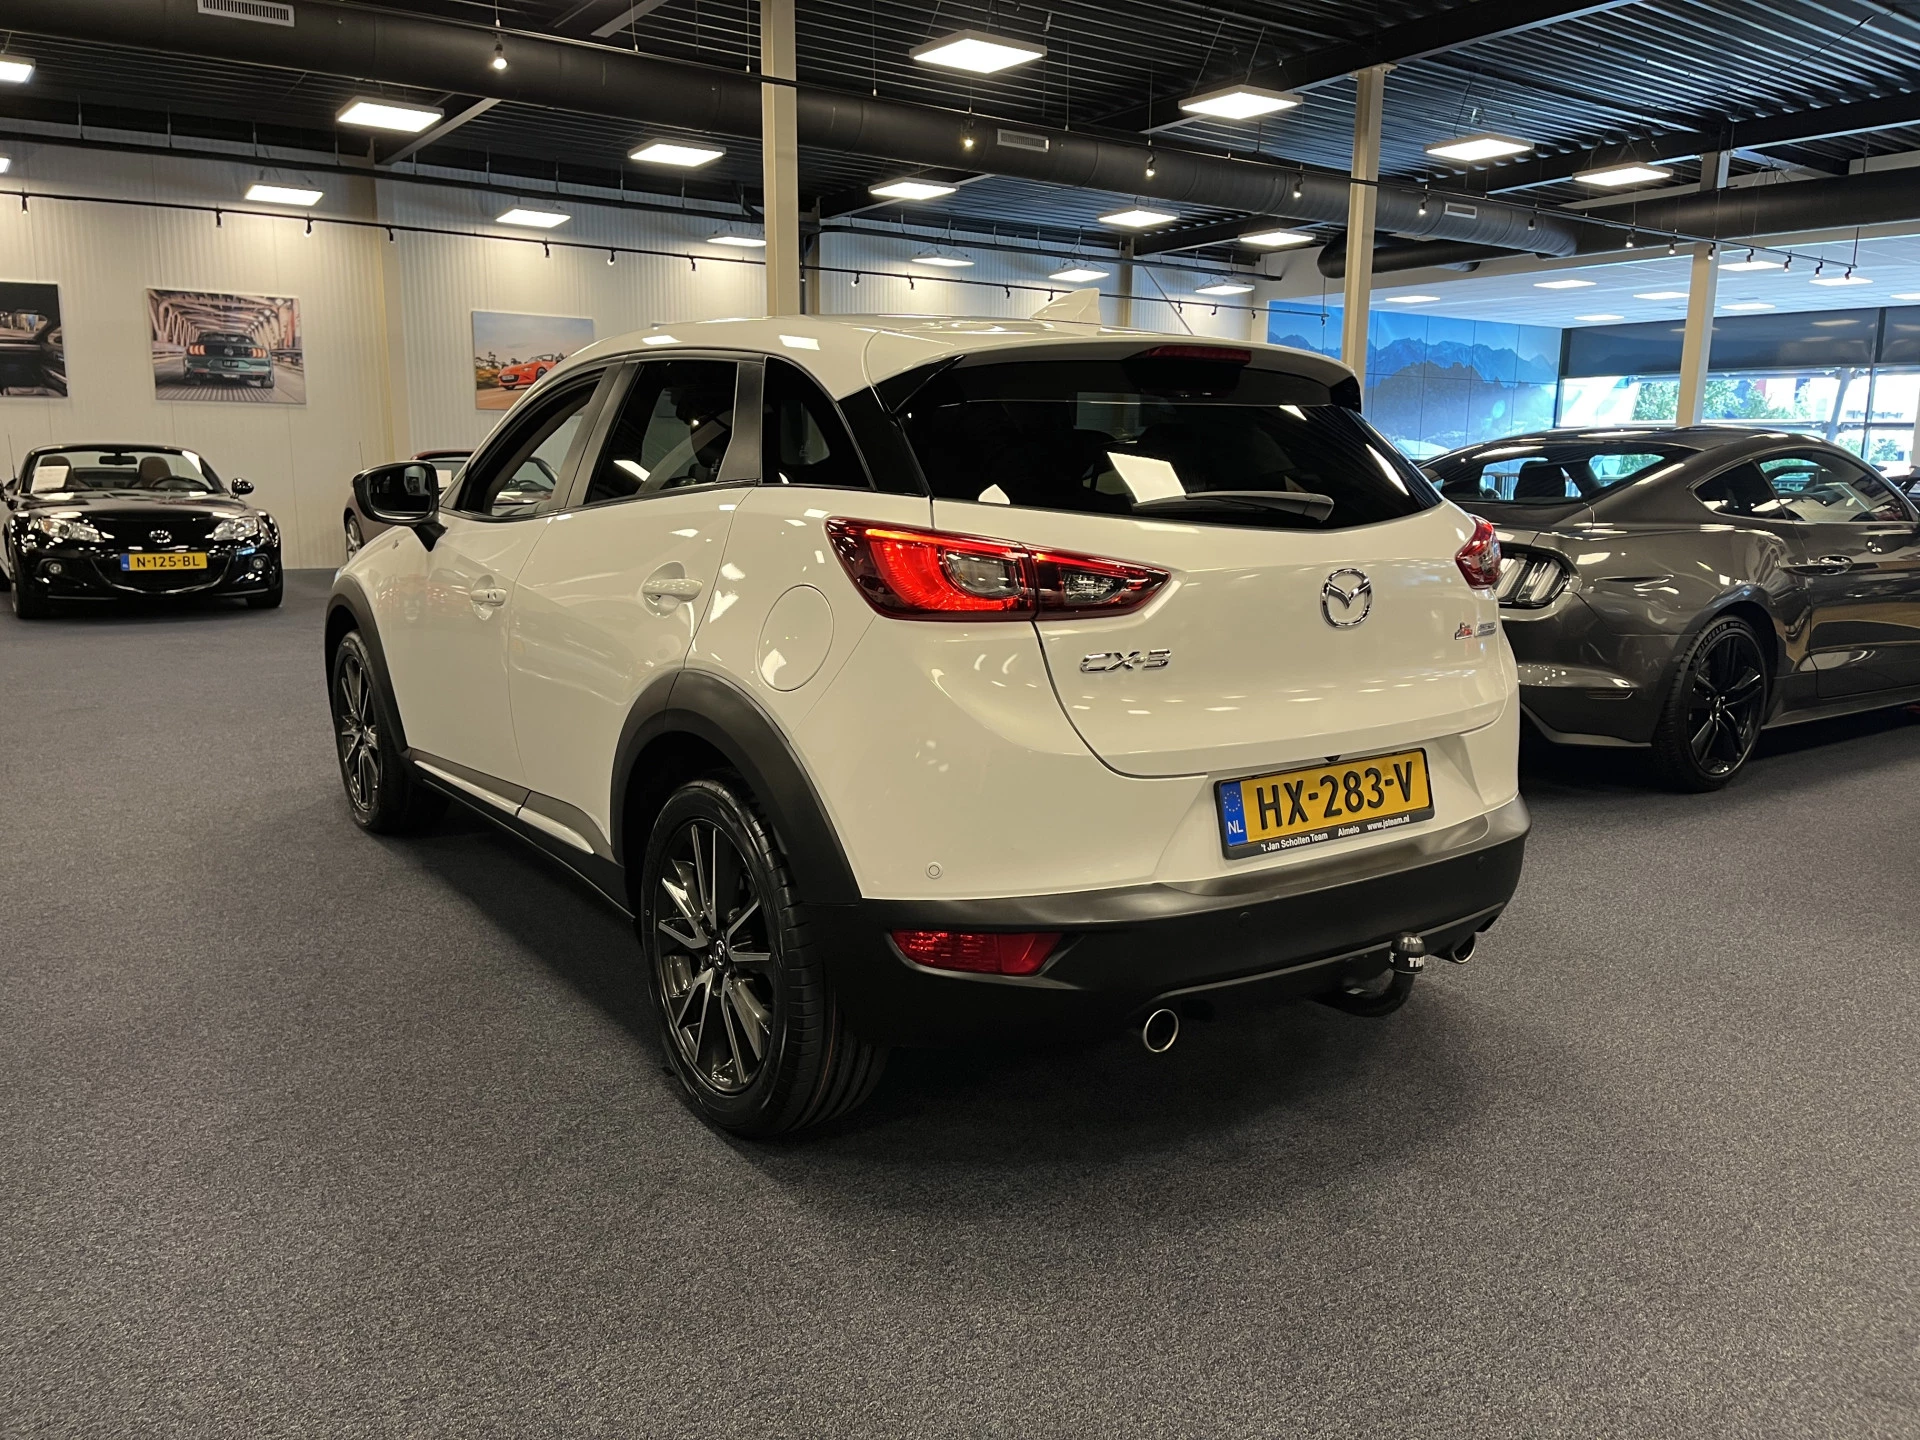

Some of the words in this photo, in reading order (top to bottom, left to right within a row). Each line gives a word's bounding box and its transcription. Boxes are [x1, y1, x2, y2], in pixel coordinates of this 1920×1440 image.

[136, 555, 201, 568] N-125-BL
[1256, 761, 1413, 830] HX-283-V
[1227, 820, 1244, 835] NL
[1267, 842, 1280, 851] Jan
[1280, 835, 1311, 848] Scholten
[1310, 832, 1329, 842] Team
[1337, 825, 1360, 837] Almelo
[1366, 814, 1410, 829] www.jsteam.nl
